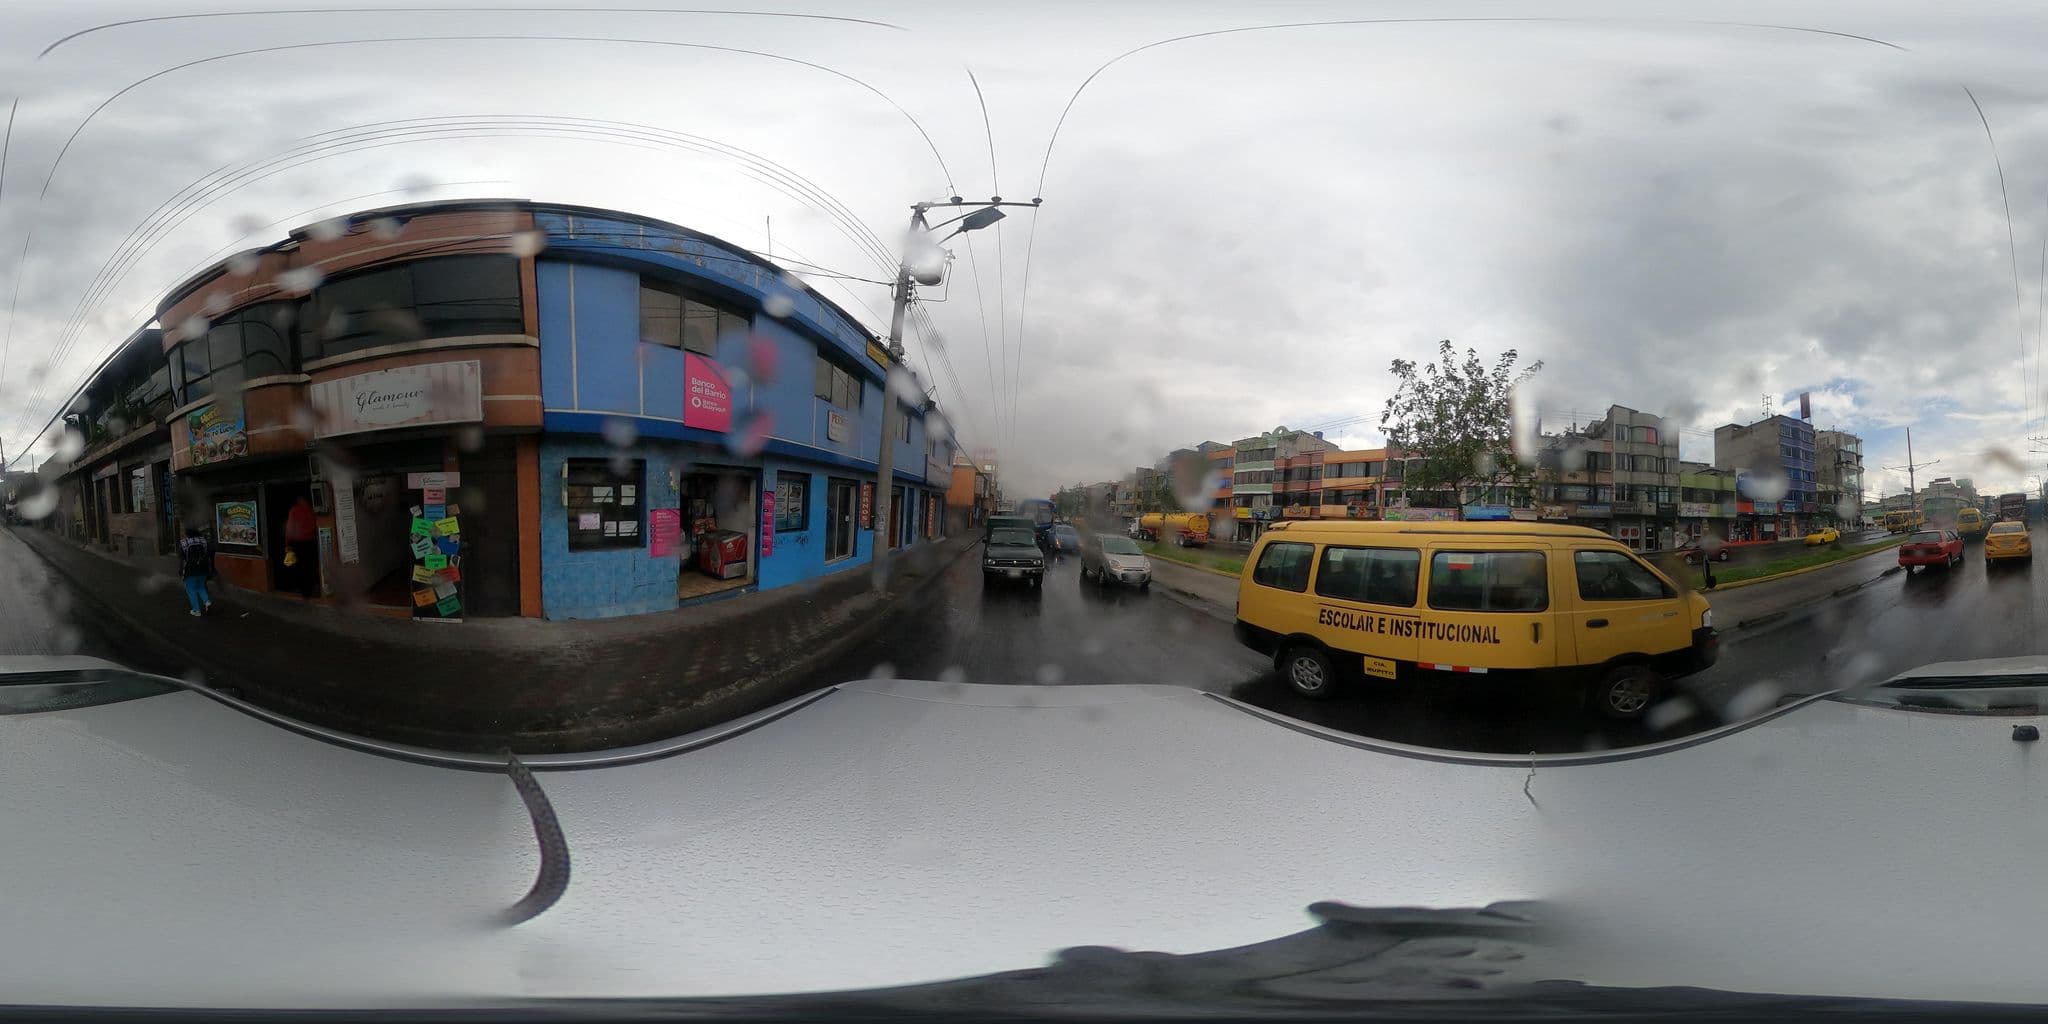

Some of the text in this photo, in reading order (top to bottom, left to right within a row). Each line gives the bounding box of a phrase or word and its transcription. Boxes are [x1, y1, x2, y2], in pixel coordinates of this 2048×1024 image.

[691, 377, 716, 390] Banco
[691, 386, 727, 401] del Barrio
[1319, 608, 1500, 644] ESCOLAR E INSTITUCIONAL
